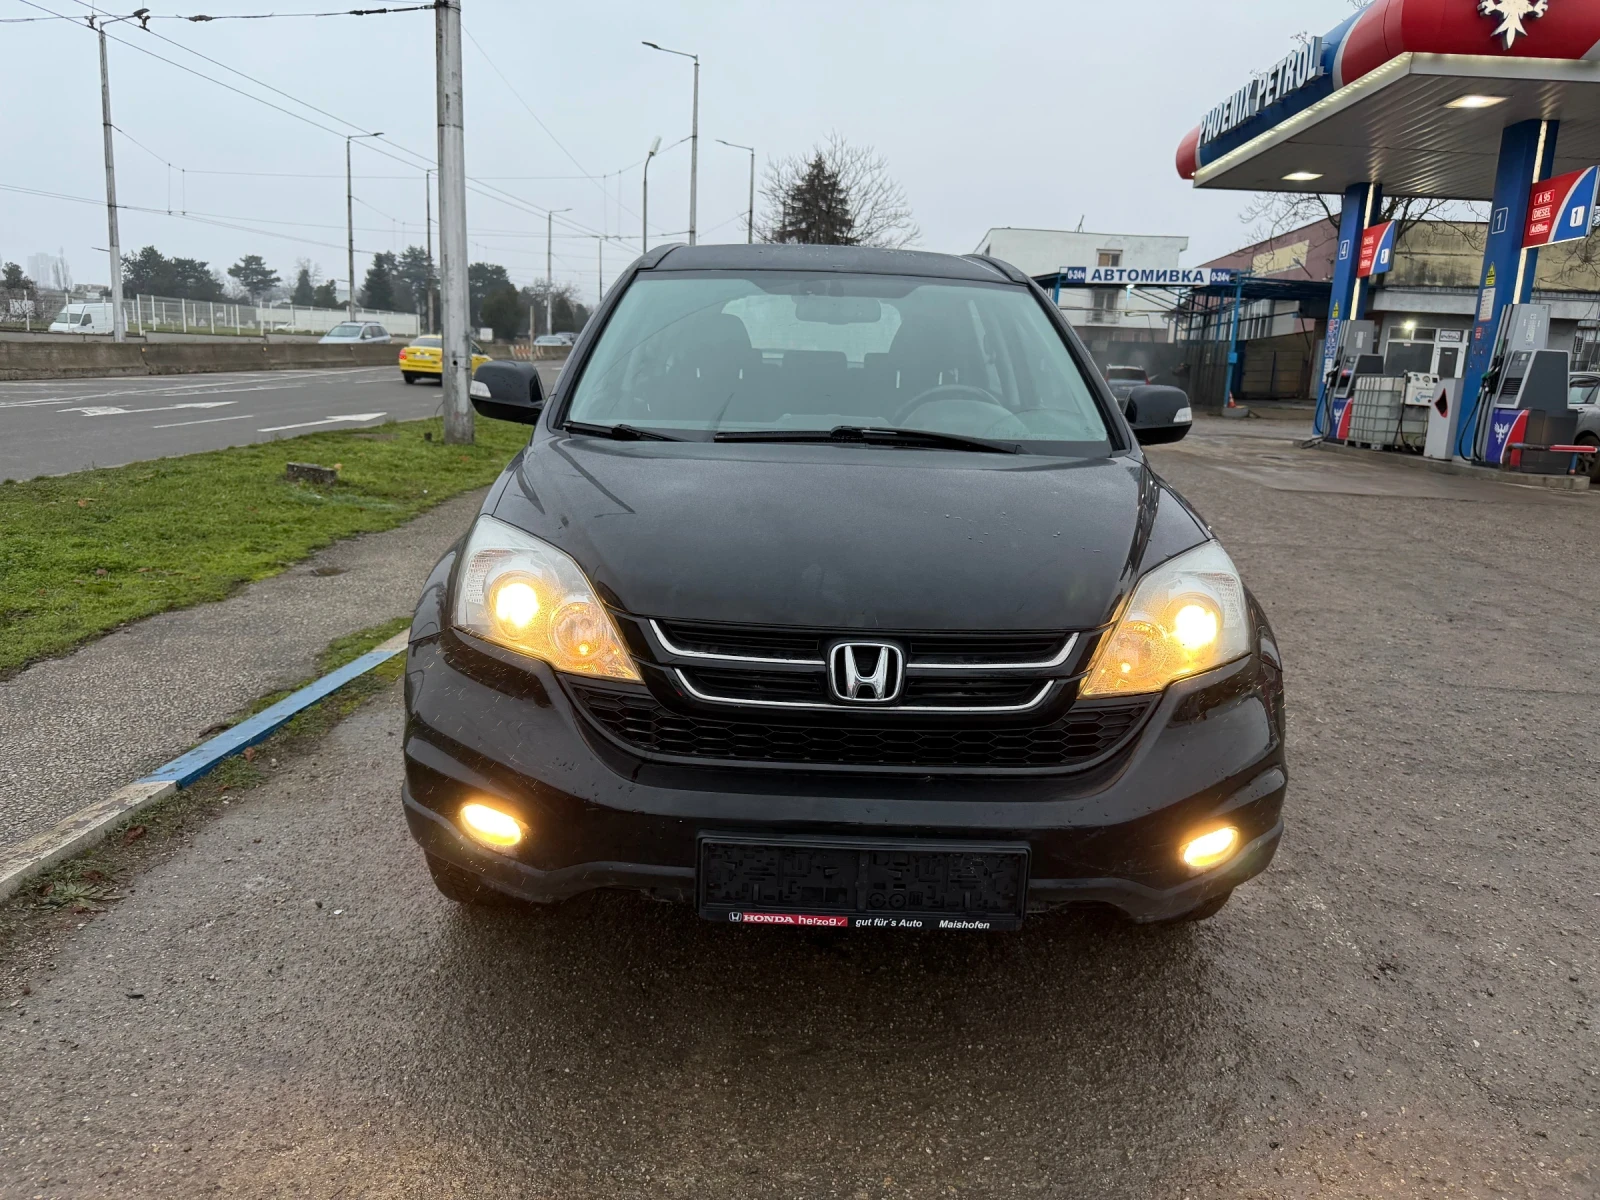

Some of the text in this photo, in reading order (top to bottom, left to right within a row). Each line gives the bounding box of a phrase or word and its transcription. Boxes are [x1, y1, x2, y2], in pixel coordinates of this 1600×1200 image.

[1197, 36, 1322, 148] PHOENIX PETROL
[1537, 191, 1551, 204] A 95
[1533, 207, 1551, 219] DIESEL
[1531, 223, 1548, 233] AdBlue
[1091, 268, 1204, 283] АВТОМИВКА
[743, 914, 795, 924] HONDA
[798, 915, 837, 926] herzog
[855, 919, 872, 928] gut
[898, 919, 923, 928] Auto
[938, 919, 990, 930] Maishofen
